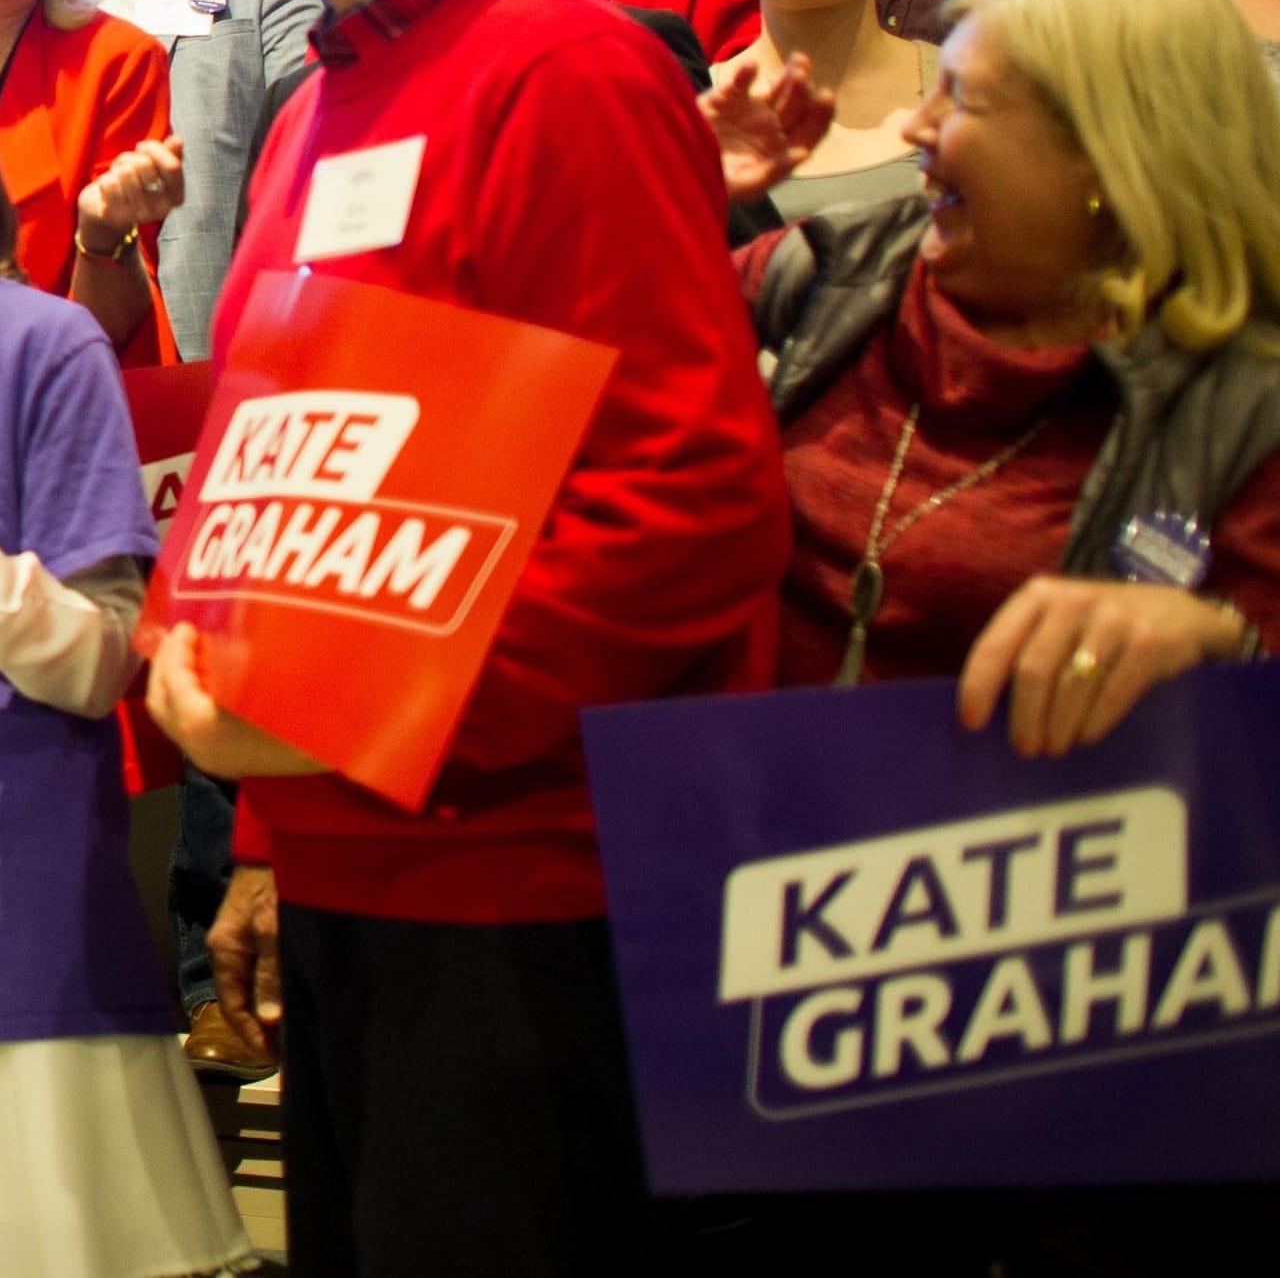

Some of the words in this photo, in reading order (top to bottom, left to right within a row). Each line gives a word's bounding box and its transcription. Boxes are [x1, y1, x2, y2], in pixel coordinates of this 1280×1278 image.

[224, 410, 383, 485] KATE
[188, 502, 473, 611] GRAHAM
[779, 816, 1127, 971] KATE
